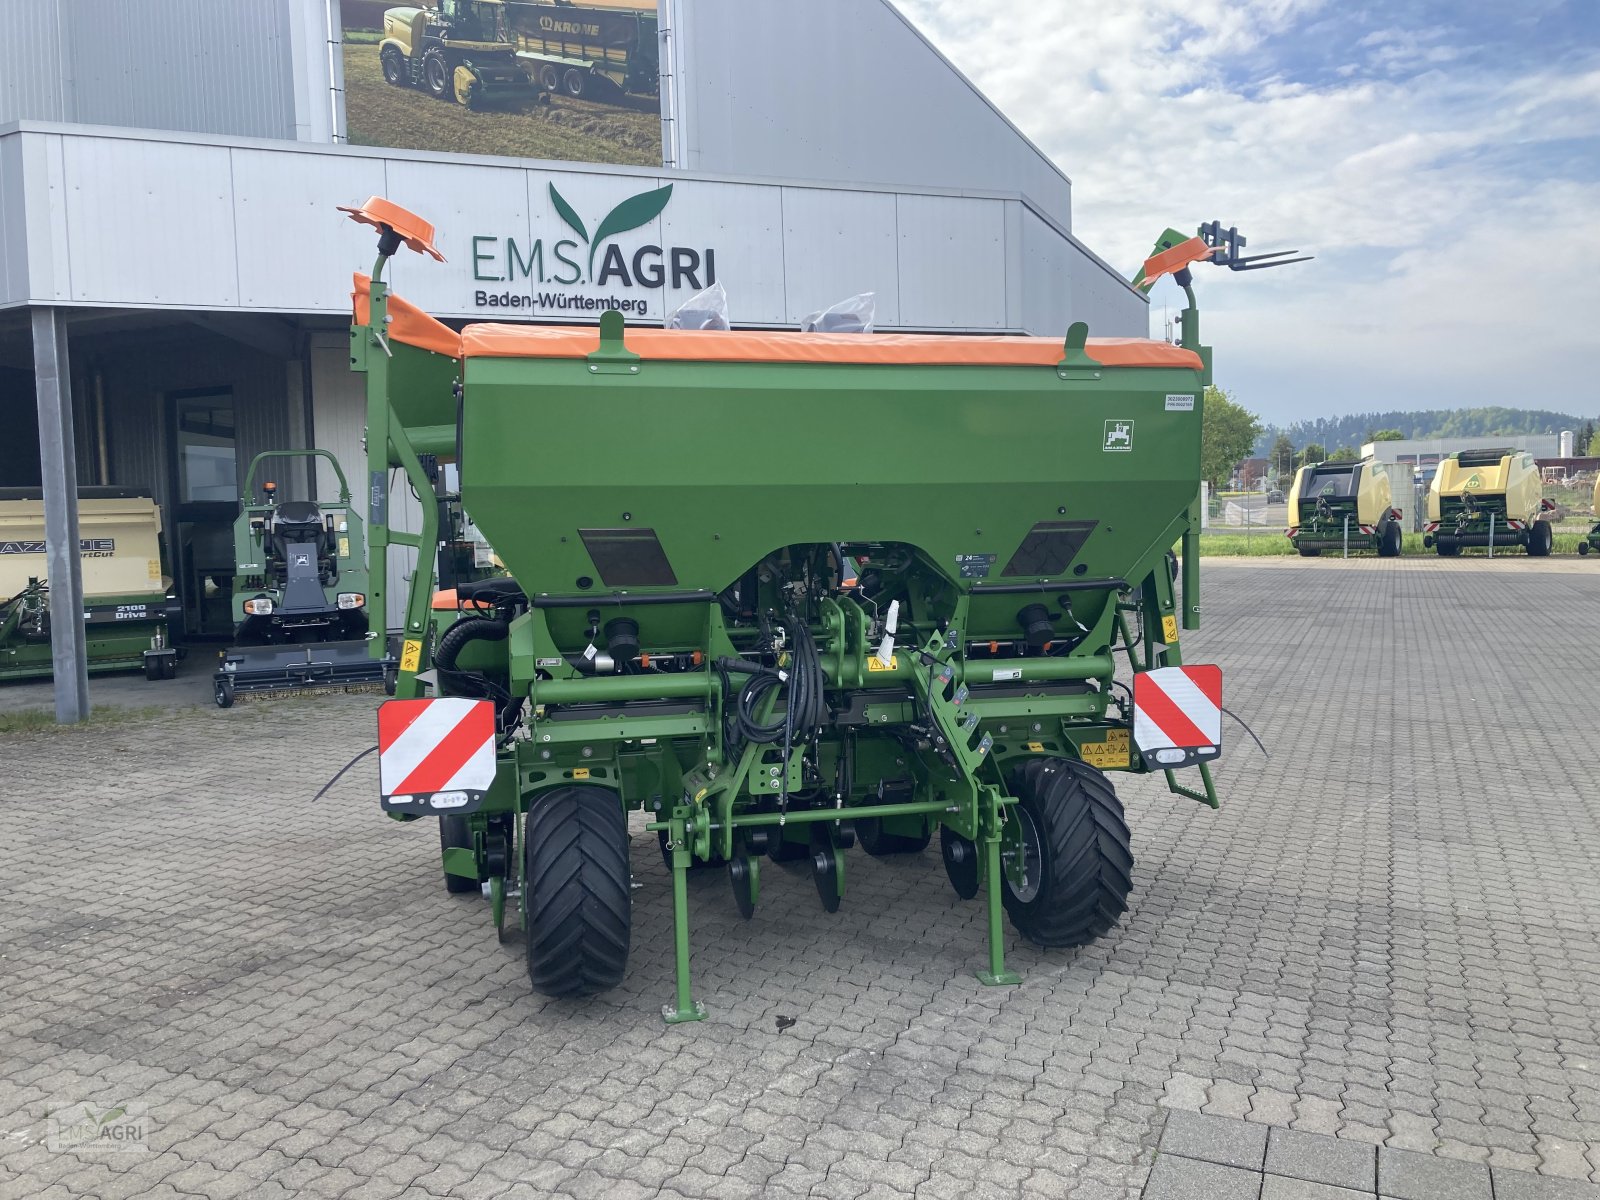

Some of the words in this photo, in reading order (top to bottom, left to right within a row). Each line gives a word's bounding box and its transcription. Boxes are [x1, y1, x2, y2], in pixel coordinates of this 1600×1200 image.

[553, 21, 600, 36] KRONE
[597, 243, 716, 290] AGRI
[475, 290, 648, 315] Baden-Württemberg
[115, 611, 147, 619] Drive
[116, 604, 146, 612] 2100
